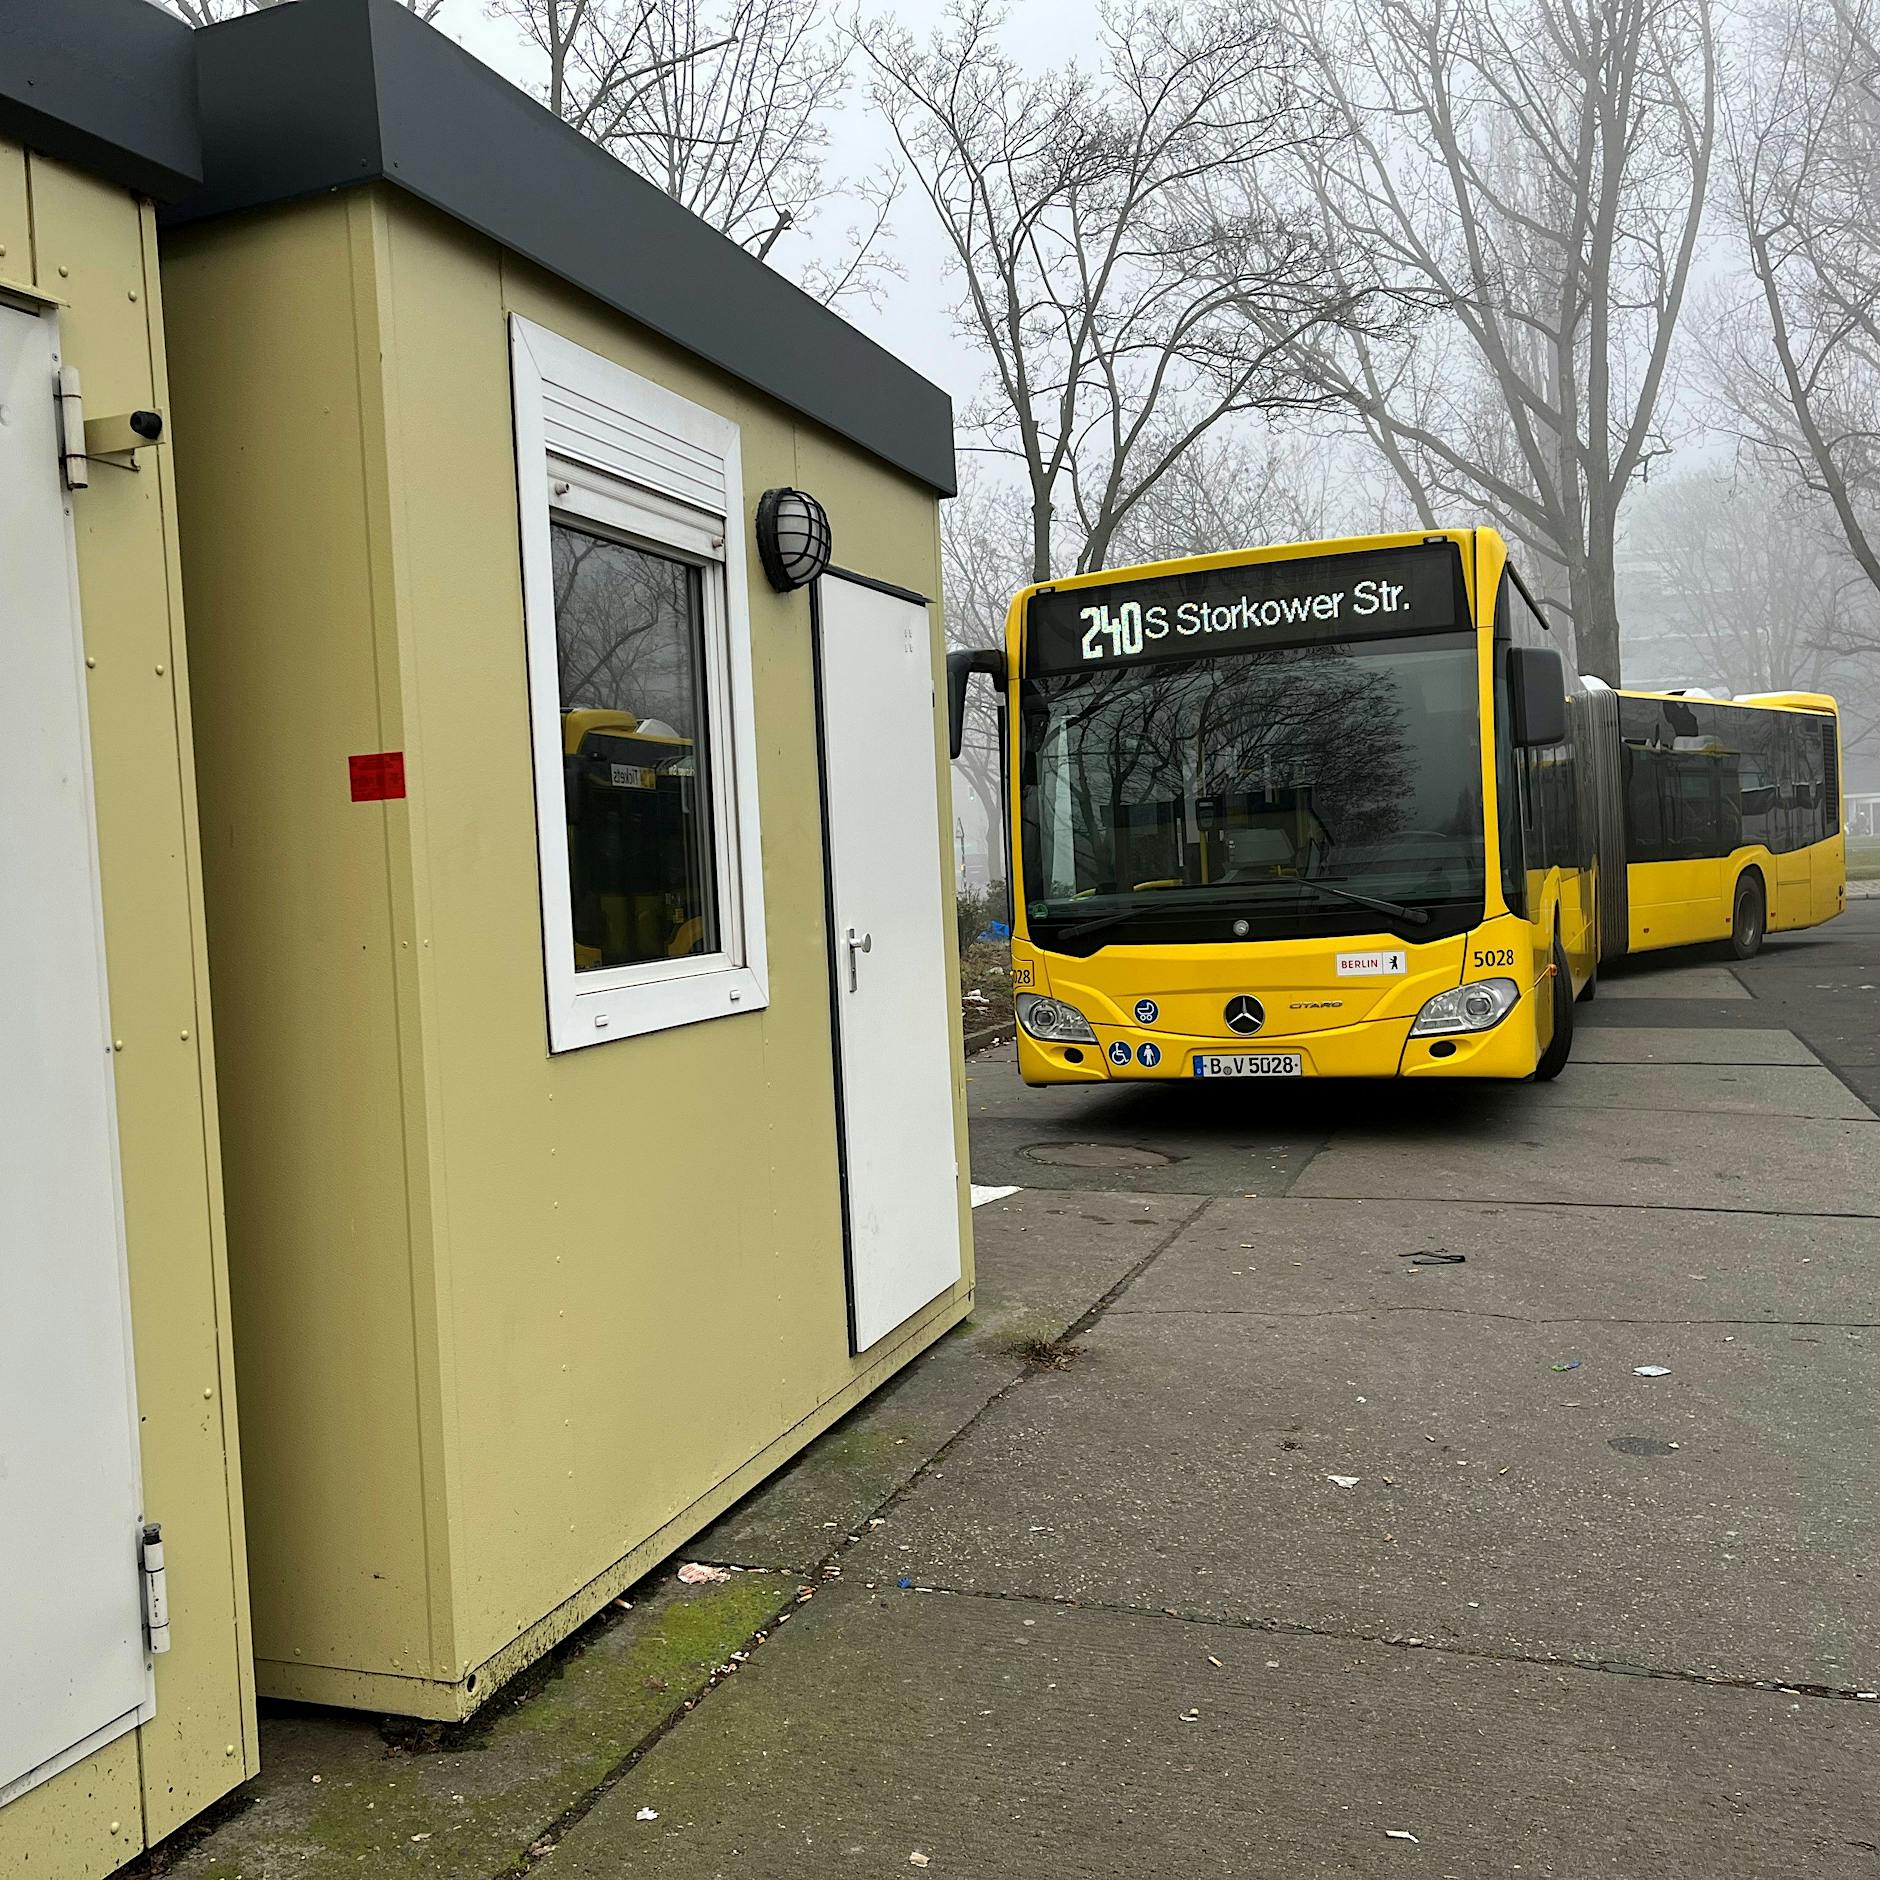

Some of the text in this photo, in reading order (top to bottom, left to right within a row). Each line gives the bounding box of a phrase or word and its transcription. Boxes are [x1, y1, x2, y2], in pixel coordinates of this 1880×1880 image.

[1079, 580, 1411, 660] 240 S Storkower Str.
[1340, 958, 1379, 970] BERLIN
[1473, 949, 1515, 968] 5028
[1289, 1001, 1343, 1010] CITARO
[1210, 1056, 1294, 1075] B V 5028
